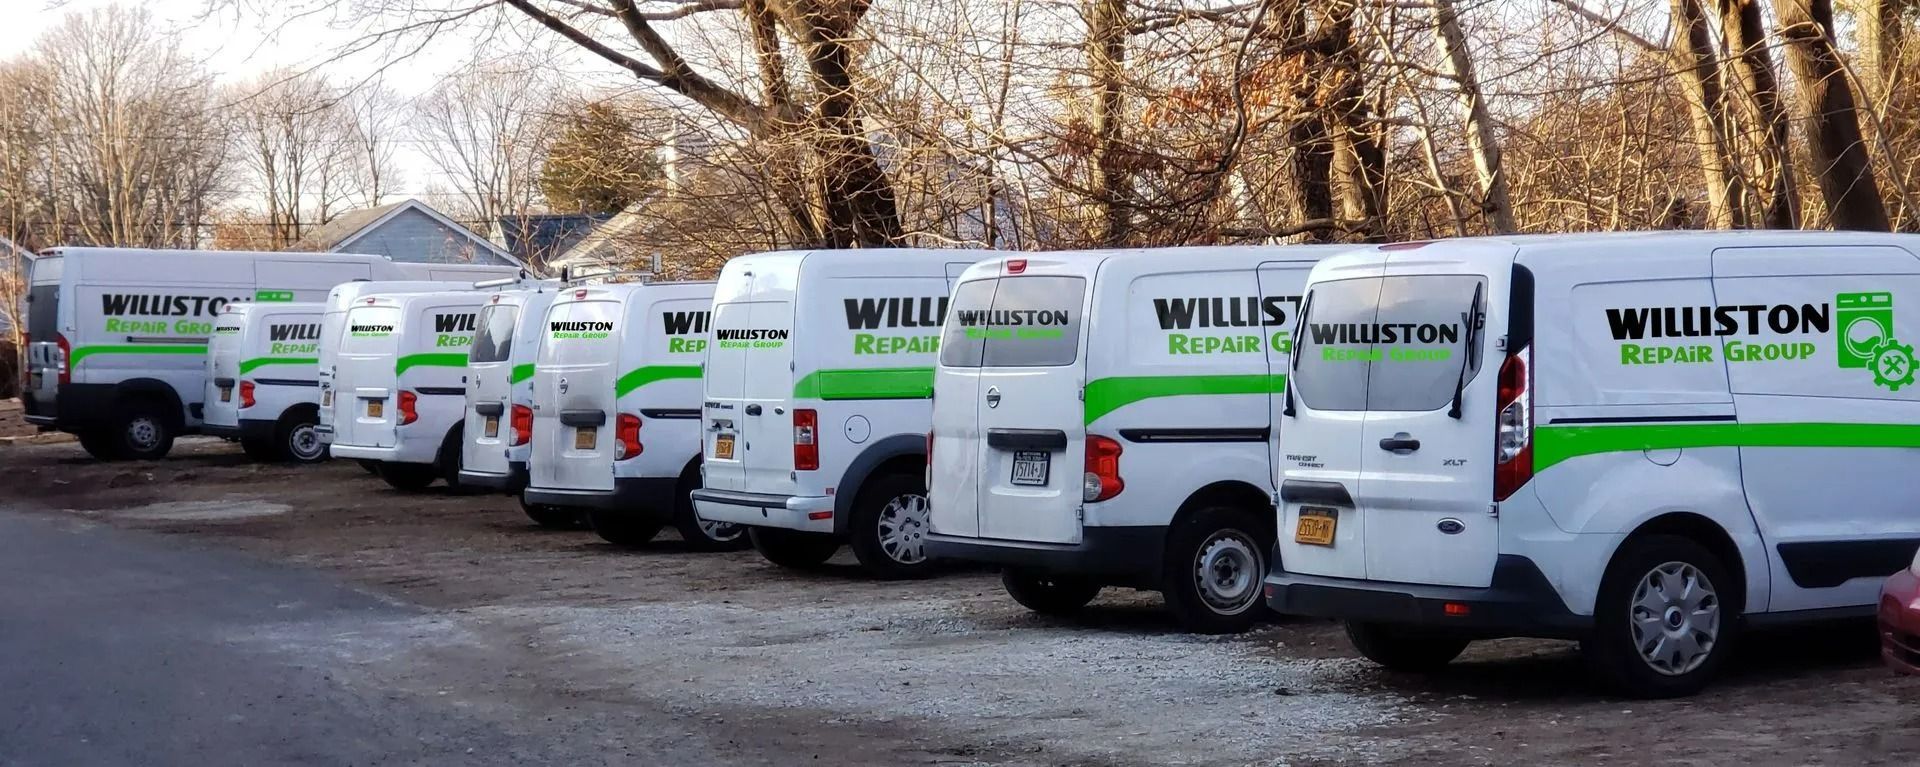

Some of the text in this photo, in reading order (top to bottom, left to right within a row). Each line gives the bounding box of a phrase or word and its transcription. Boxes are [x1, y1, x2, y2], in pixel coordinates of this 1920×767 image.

[102, 294, 250, 317] WILLISTO
[1153, 296, 1303, 330] WILLIST
[551, 321, 613, 331] WILLISTON
[958, 309, 1069, 326] WILLISTON
[1605, 303, 1830, 340] WILLISTON
[717, 329, 788, 340] WILLISTON
[1310, 323, 1458, 344] WILLISTON
[1724, 341, 1816, 362] GROUP
